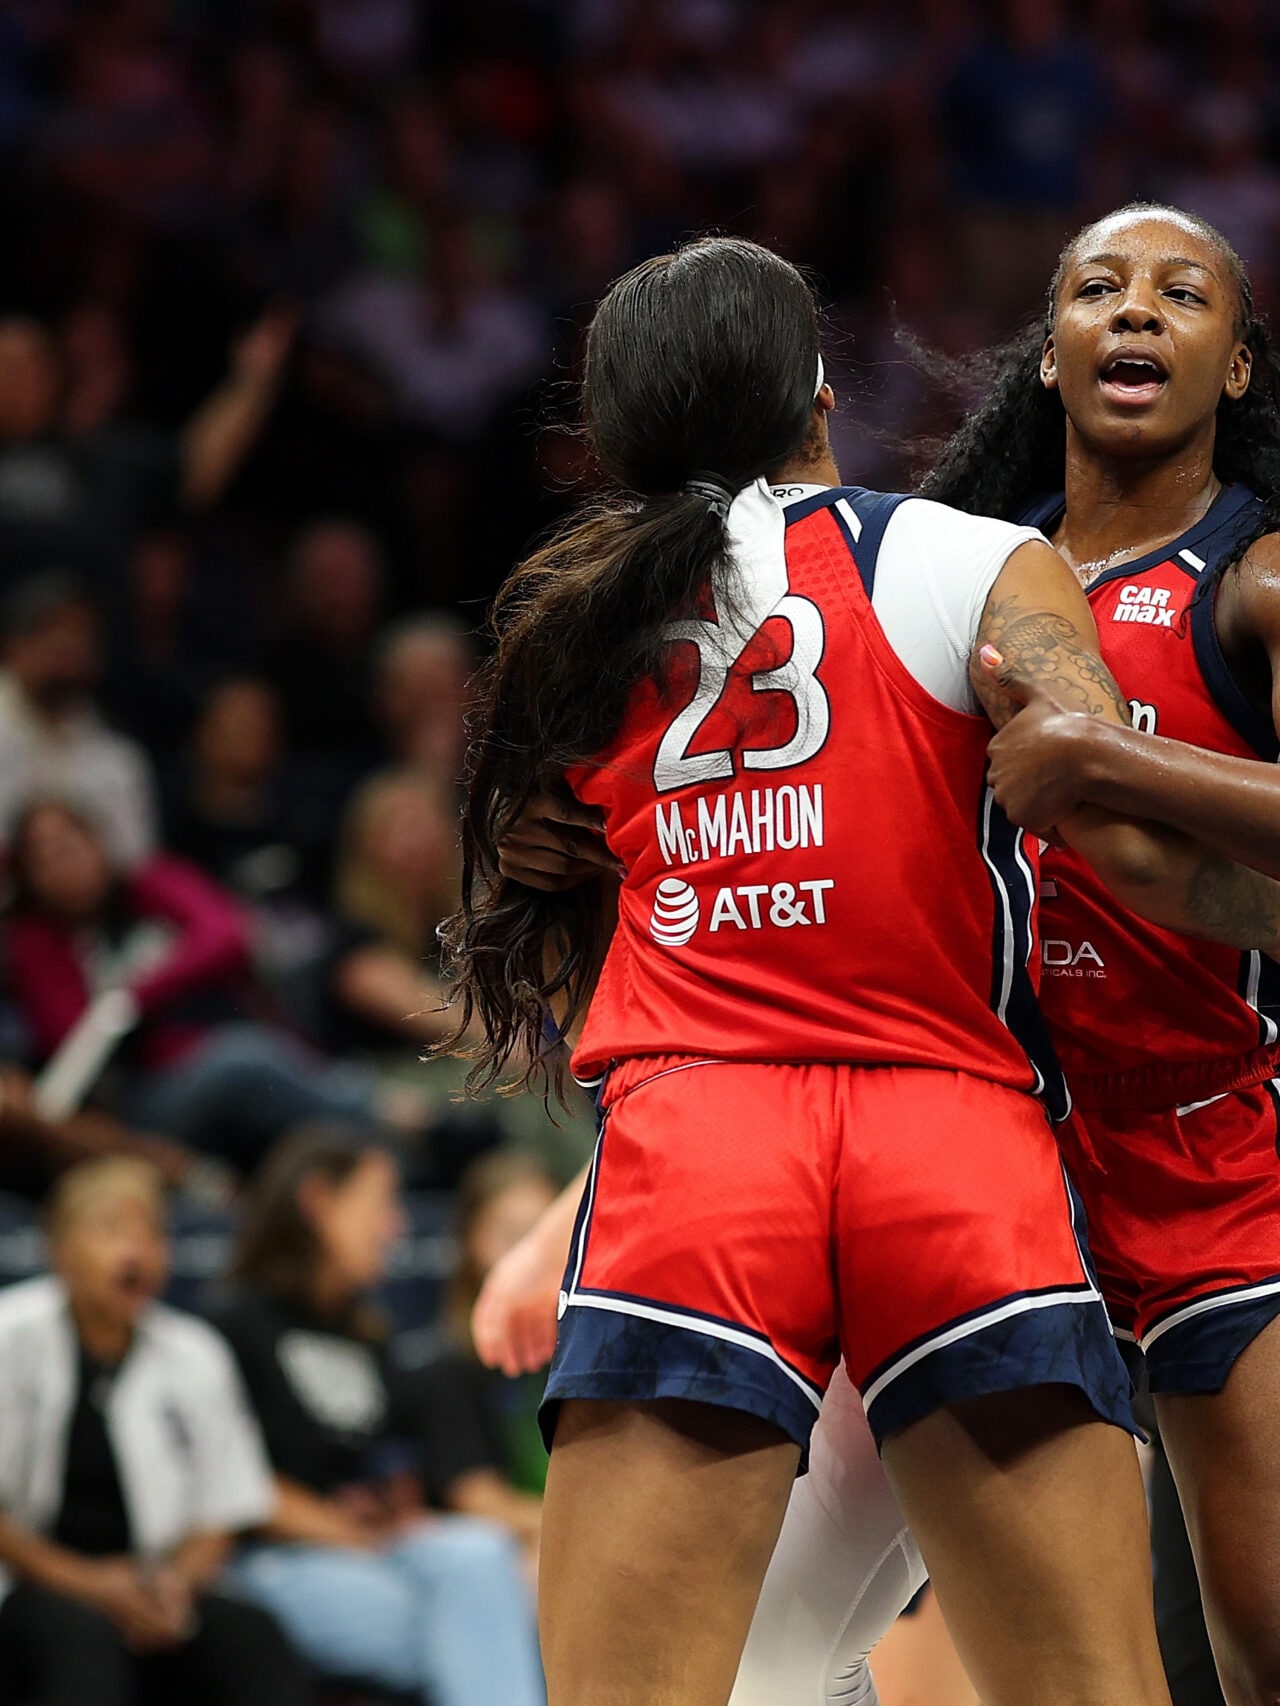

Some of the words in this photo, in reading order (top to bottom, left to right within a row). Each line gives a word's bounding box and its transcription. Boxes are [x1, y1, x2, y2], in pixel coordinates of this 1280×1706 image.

[1112, 603, 1177, 627] max
[1119, 585, 1171, 607] CAR
[653, 594, 830, 793] 23
[655, 784, 824, 866] McMAHON
[708, 879, 835, 932] AT&T
